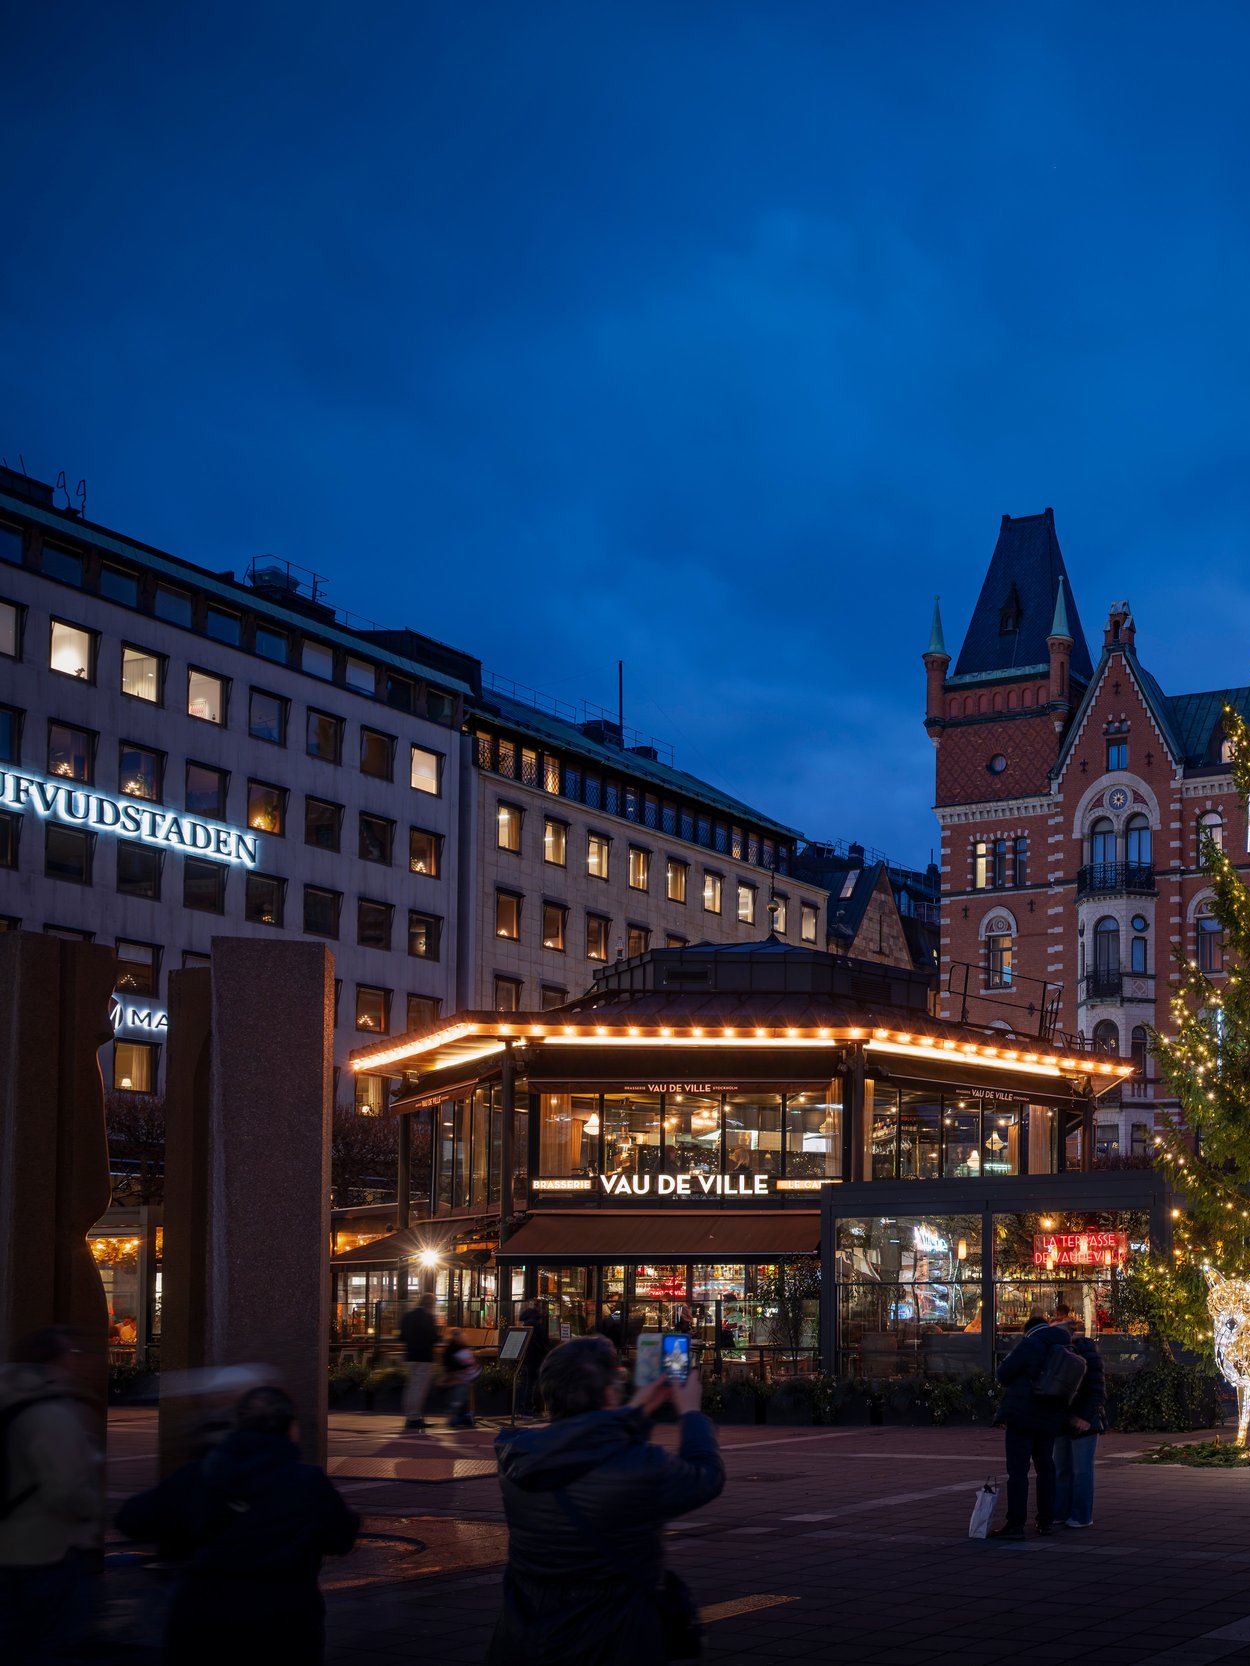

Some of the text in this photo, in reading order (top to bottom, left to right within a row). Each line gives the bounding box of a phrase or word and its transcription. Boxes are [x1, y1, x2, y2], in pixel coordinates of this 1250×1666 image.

[647, 1084, 667, 1092] VAU
[669, 1084, 682, 1092] DE
[684, 1084, 711, 1092] VILLE
[972, 1089, 985, 1097] VAU
[985, 1091, 995, 1099] DE
[995, 1092, 1013, 1101] VILLE
[533, 1181, 591, 1189] BRASSERIE
[600, 1174, 650, 1194] VAU
[658, 1174, 691, 1194] DE
[698, 1174, 768, 1194] VILLE
[788, 1180, 800, 1189] LE
[1043, 1236, 1057, 1247] LA
